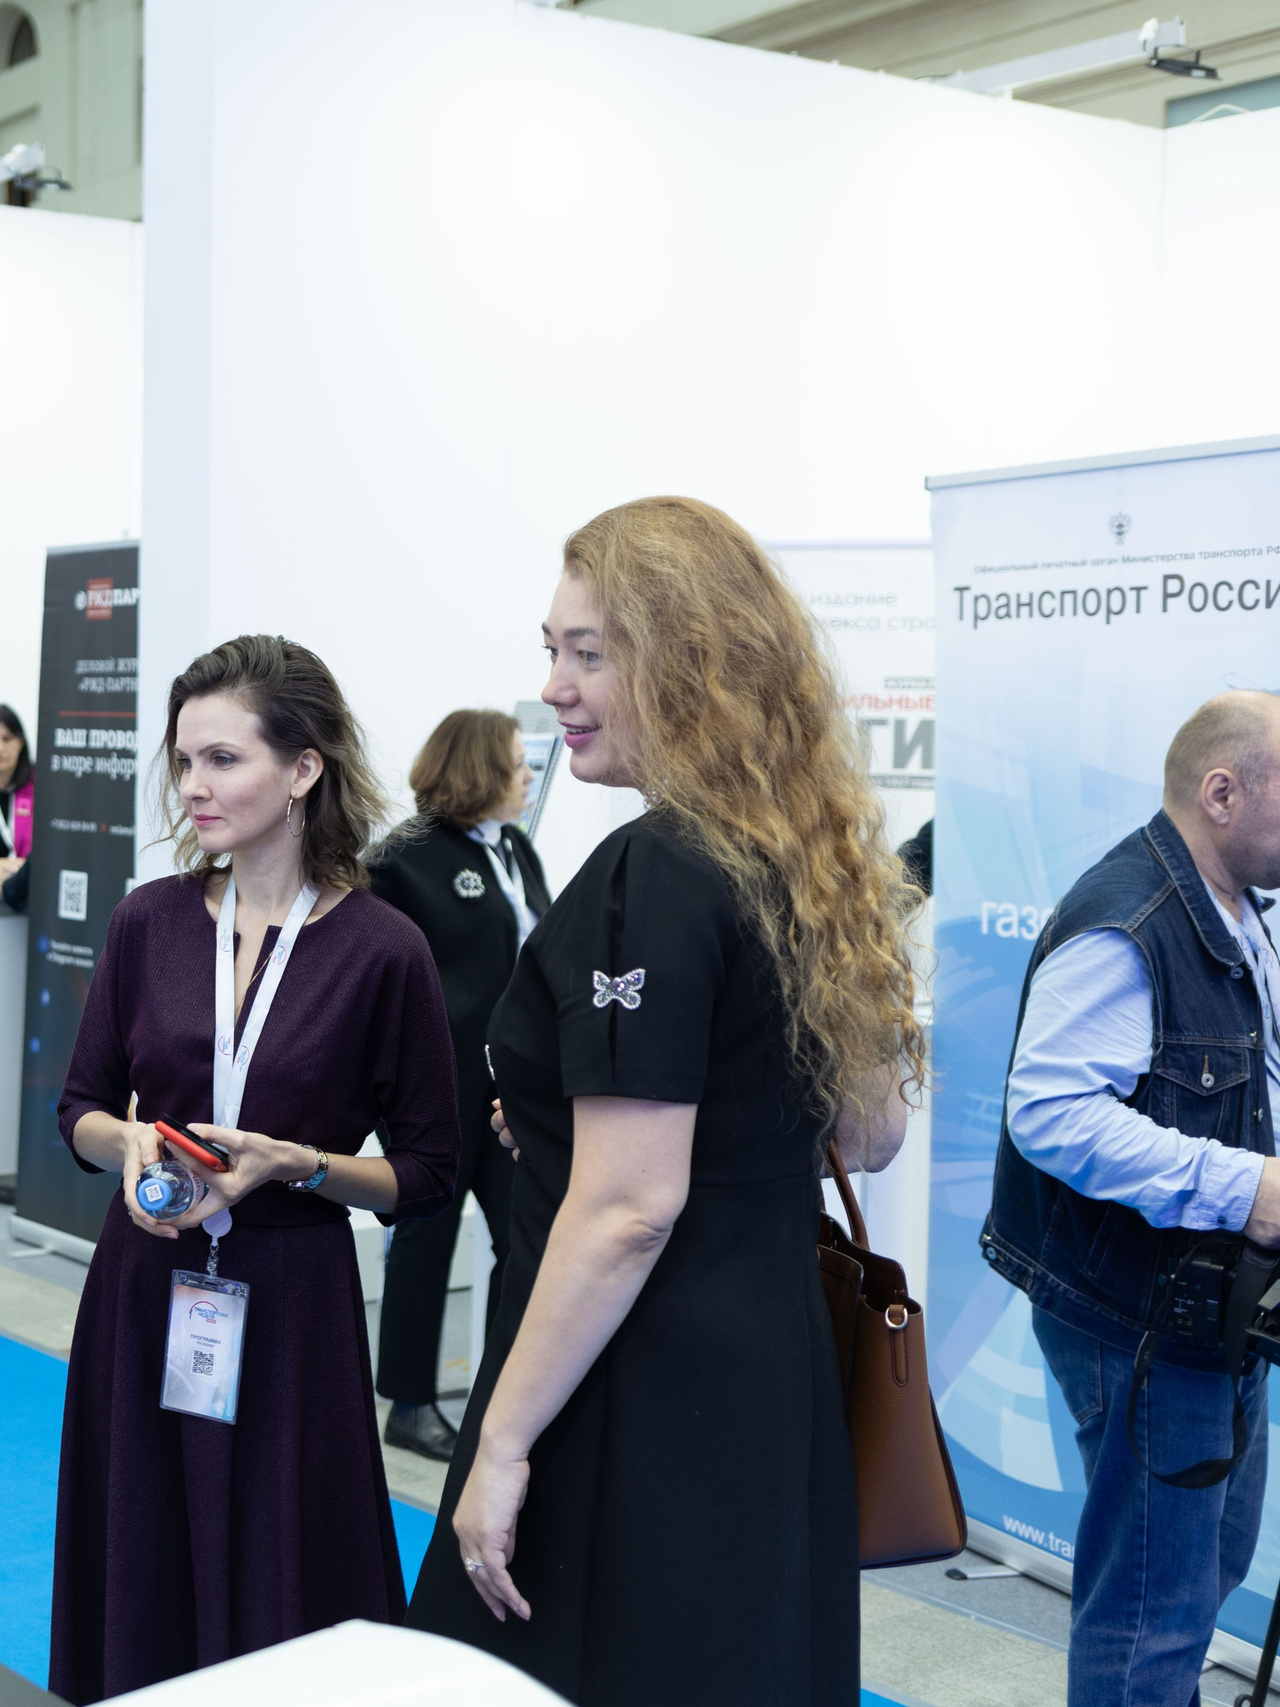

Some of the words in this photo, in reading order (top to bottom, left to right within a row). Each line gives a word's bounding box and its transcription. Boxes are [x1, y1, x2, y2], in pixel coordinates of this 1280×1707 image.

[974, 562, 1039, 574] Официальный
[1041, 558, 1088, 570] печатный
[1090, 557, 1118, 568] орган
[1121, 550, 1196, 565] Министерства
[1198, 547, 1263, 561] транспорта
[810, 592, 897, 607] издание
[953, 585, 1149, 630] Транспорт
[1162, 573, 1280, 613] Росси
[54, 728, 87, 748] ВАШ
[61, 755, 93, 778] море
[94, 752, 138, 781] инфор
[191, 1334, 221, 1344] ПРОГРАММА
